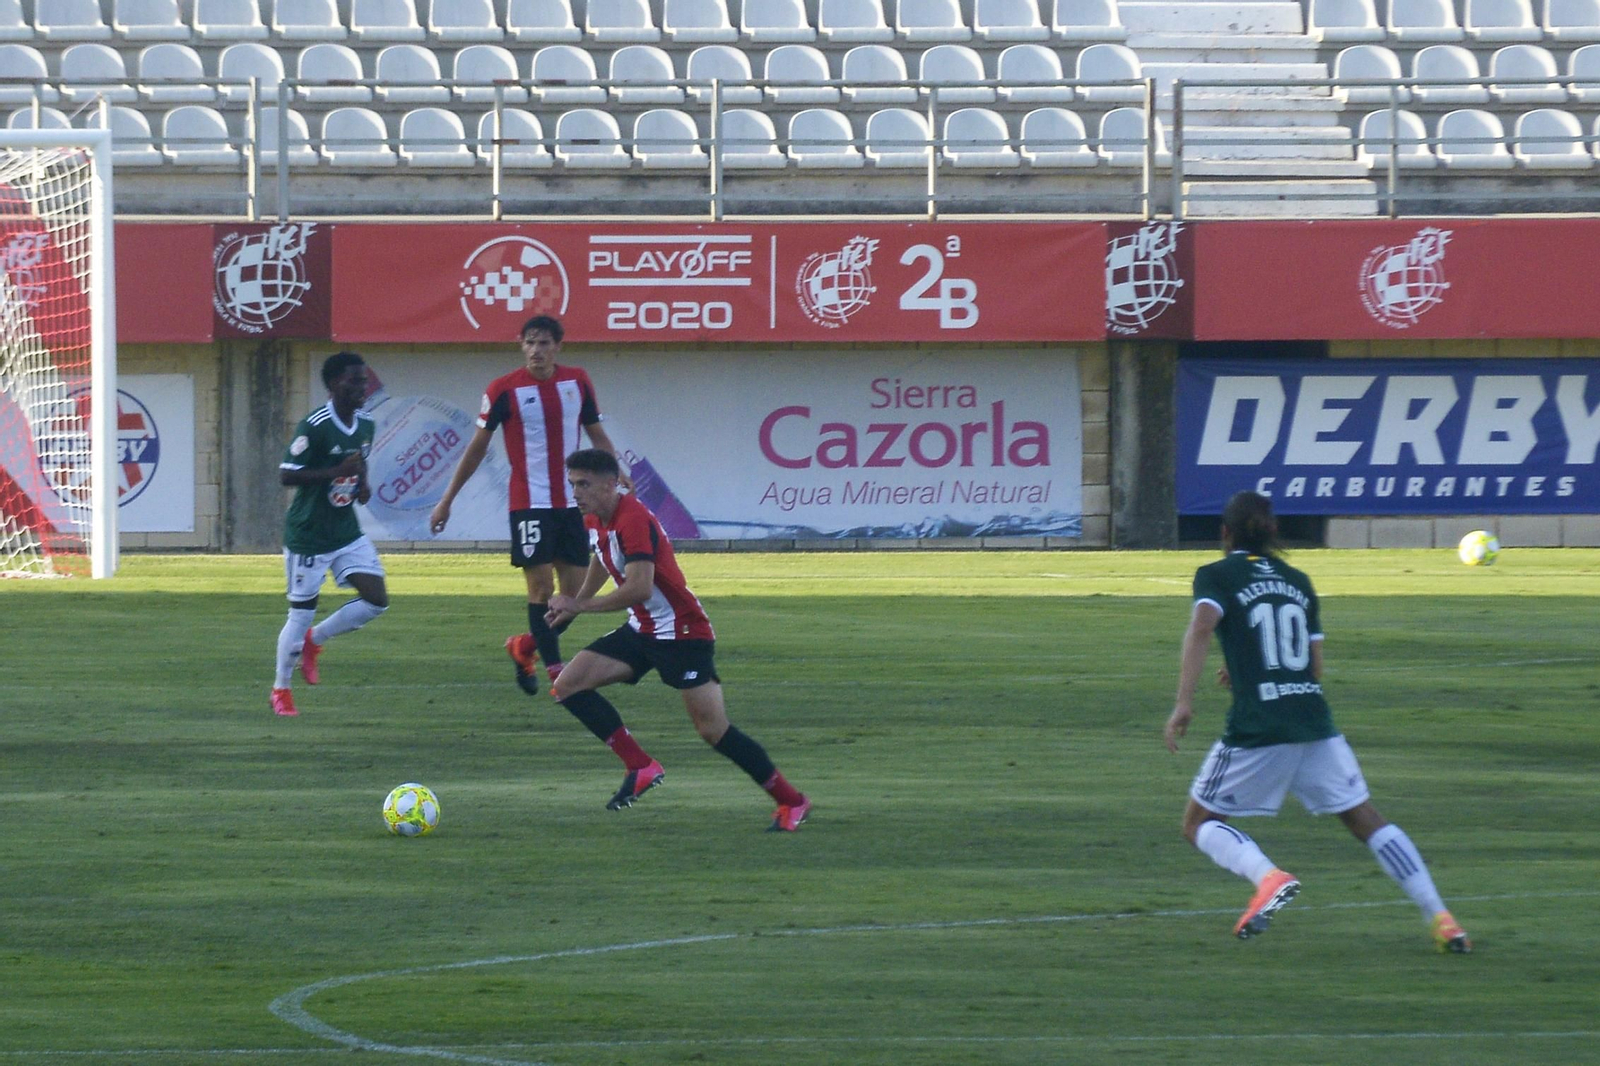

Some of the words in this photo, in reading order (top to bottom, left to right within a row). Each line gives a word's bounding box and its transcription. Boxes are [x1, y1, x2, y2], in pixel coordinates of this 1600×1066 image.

[589, 250, 752, 277] PLAYOFF
[607, 301, 733, 330] 2020
[870, 378, 978, 409] Sierra
[758, 400, 1052, 469] Cazorla
[1197, 375, 1600, 465] DERBY
[377, 428, 461, 504] Cazorla
[396, 432, 431, 467] Sierra
[758, 481, 833, 512] Agua
[842, 480, 945, 506] Mineral
[950, 479, 1052, 505] Natural
[1255, 476, 1578, 498] CARBURANTES
[518, 519, 542, 545] 15
[1248, 602, 1310, 672] 10
